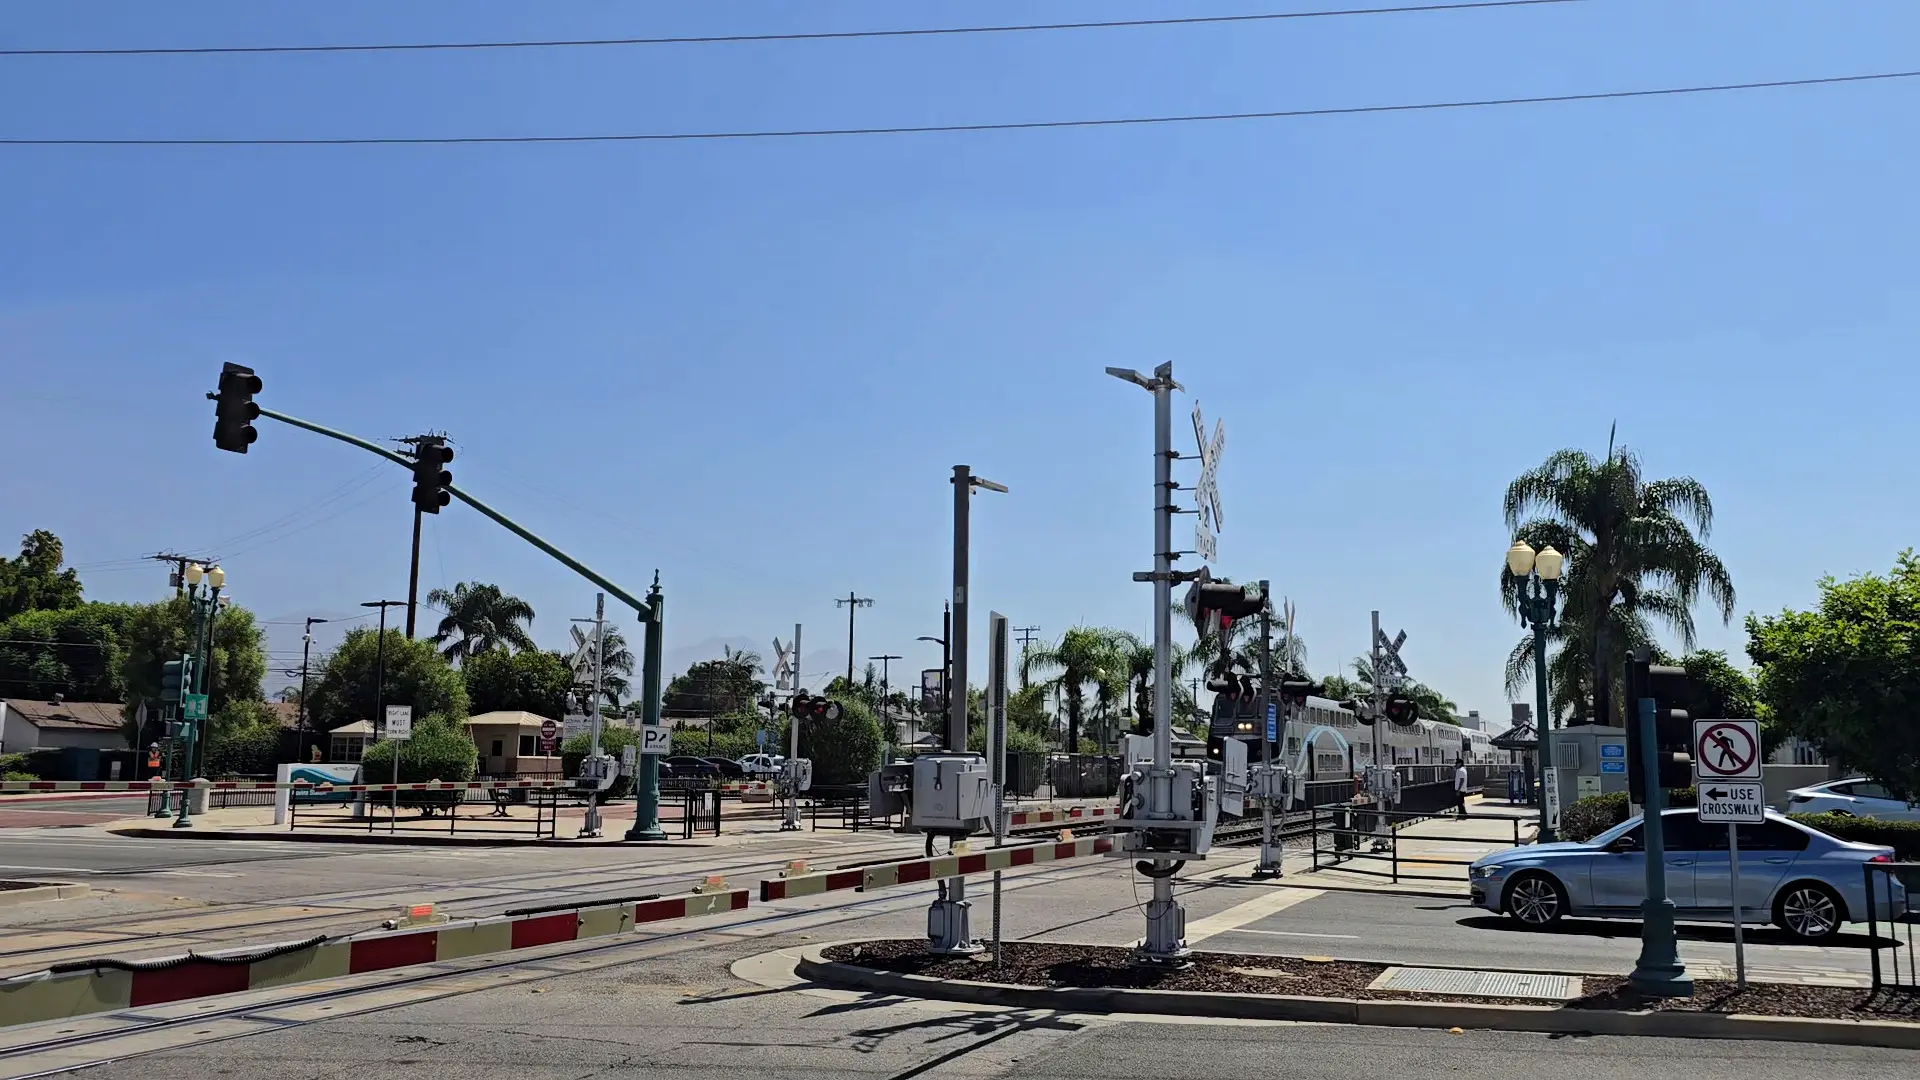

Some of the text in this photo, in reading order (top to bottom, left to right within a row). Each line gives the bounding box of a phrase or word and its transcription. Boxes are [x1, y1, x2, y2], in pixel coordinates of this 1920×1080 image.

[1197, 533, 1216, 556] TRACKS
[1730, 788, 1755, 801] USE
[1702, 802, 1760, 816] CROSSWALK
